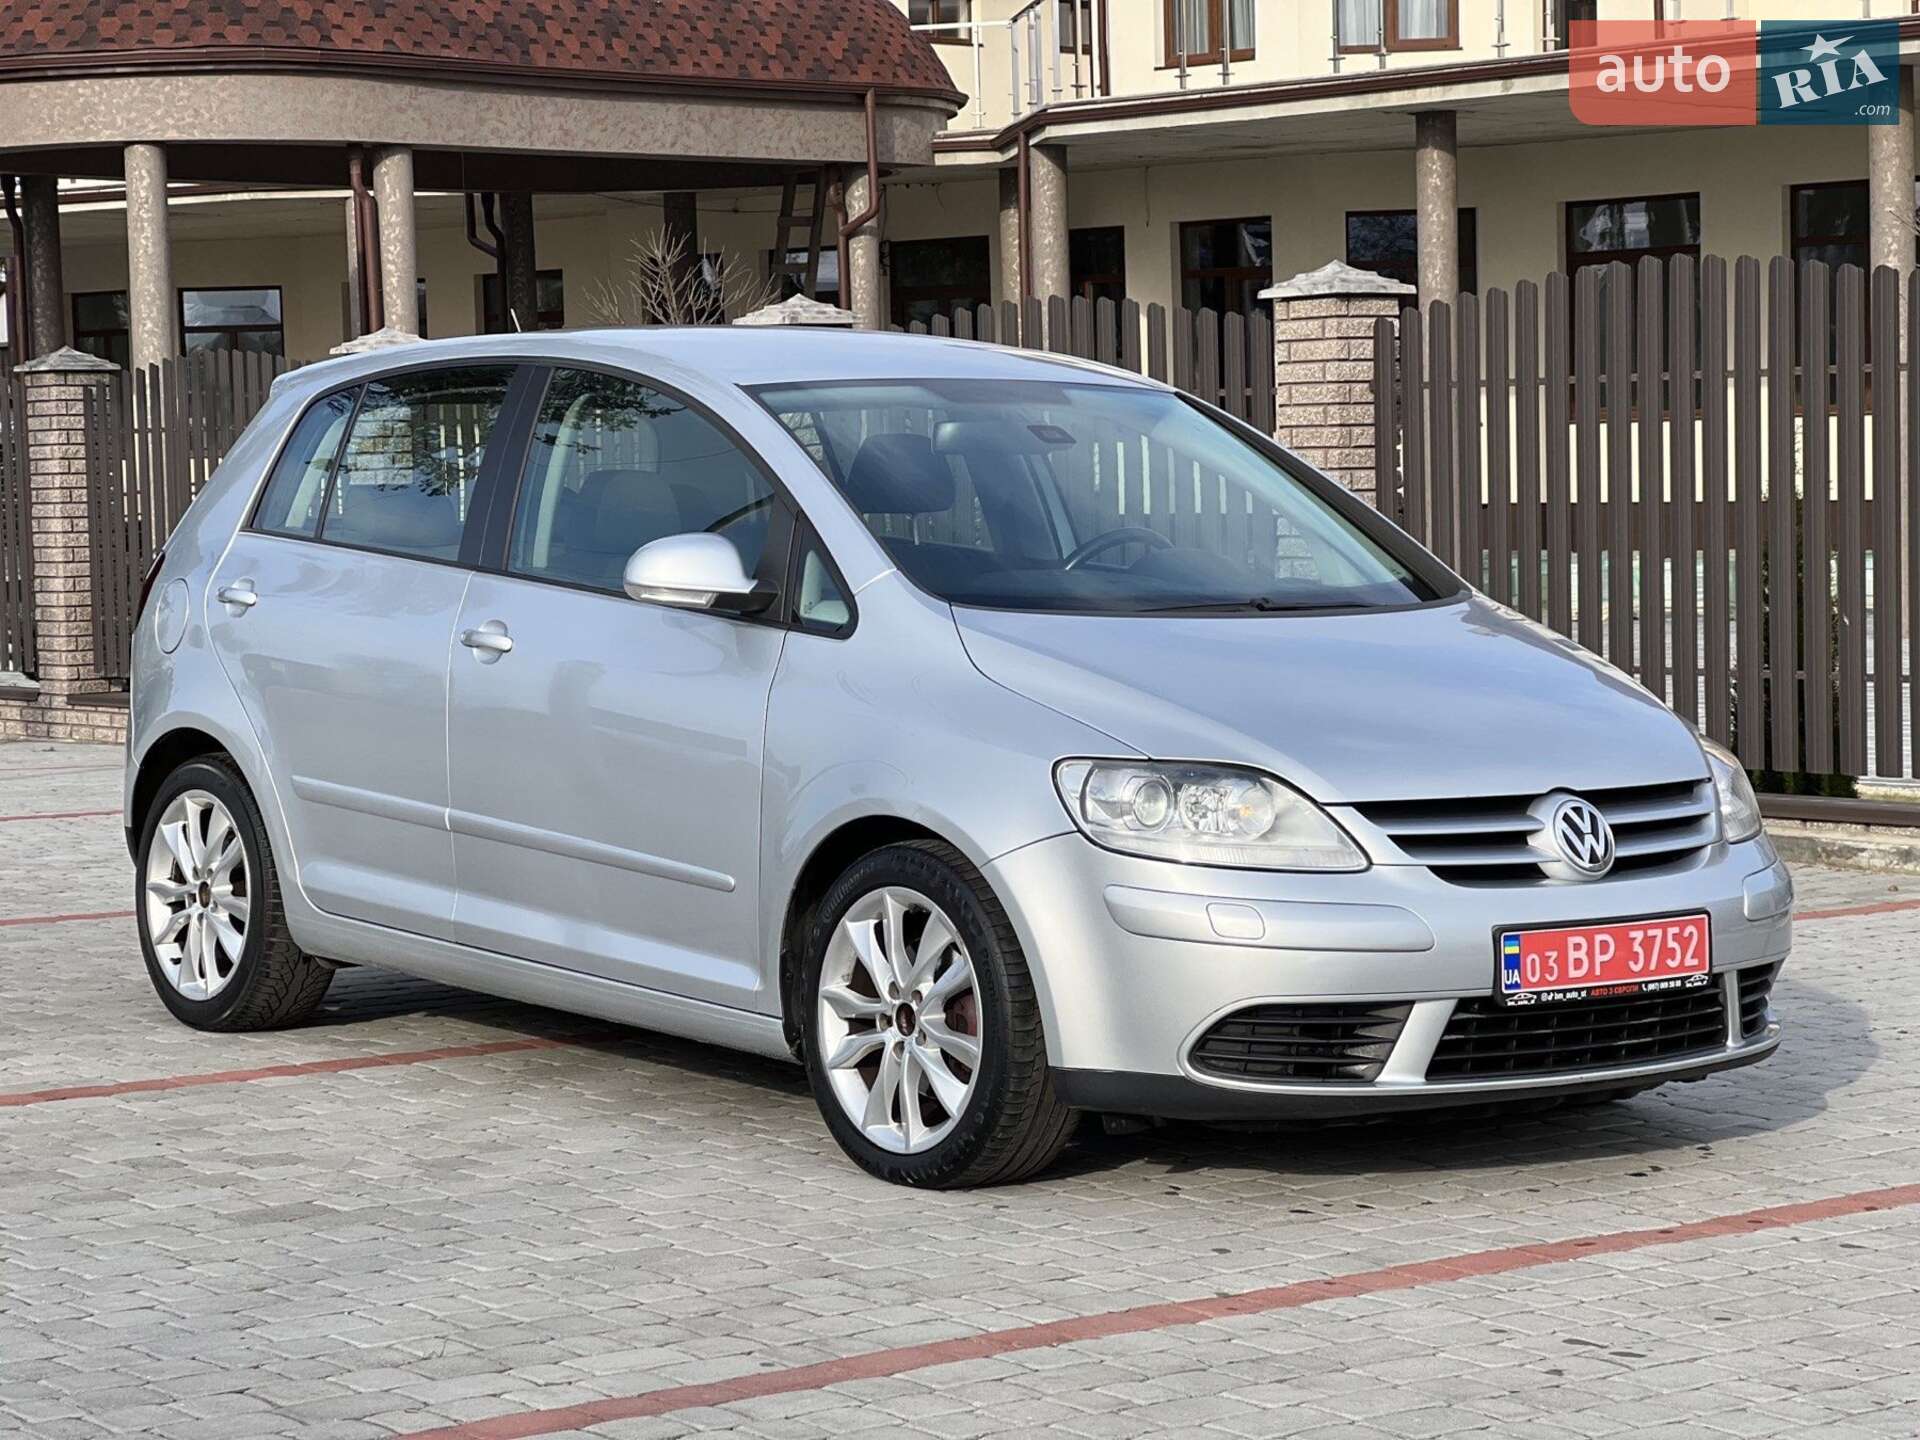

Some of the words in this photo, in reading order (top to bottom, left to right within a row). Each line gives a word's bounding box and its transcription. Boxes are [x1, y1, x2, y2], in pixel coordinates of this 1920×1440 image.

[1526, 951, 1559, 984] 03
[1567, 934, 1616, 978] BP
[1628, 924, 1699, 973] 3752
[1504, 969, 1521, 985] UA
